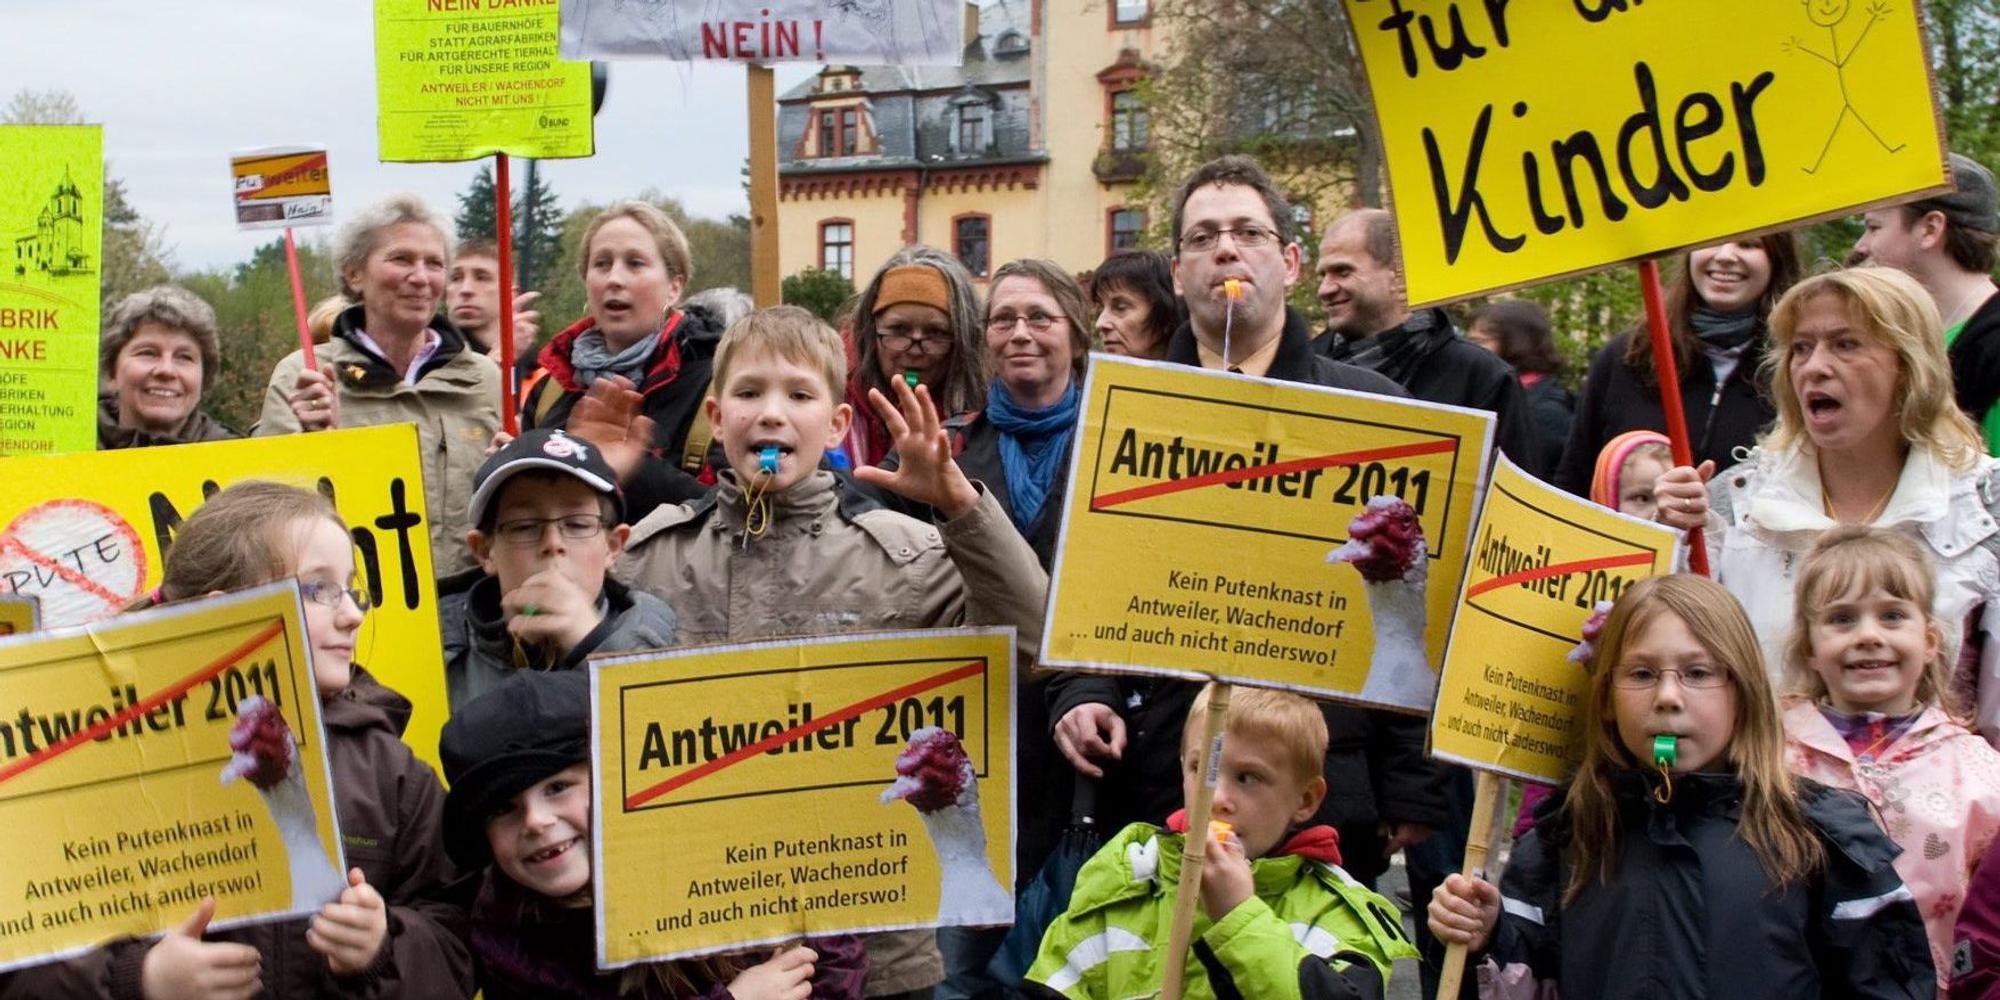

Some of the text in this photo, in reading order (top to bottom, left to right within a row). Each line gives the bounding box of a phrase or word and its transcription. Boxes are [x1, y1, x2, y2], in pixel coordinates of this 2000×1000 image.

[430, 32, 556, 48] STATT AGRARFABRIKEN
[446, 19, 544, 33] FÜR BAUERNHÖFE
[400, 50, 424, 62] FÜR
[427, 48, 510, 61] ARTGERECHTE
[440, 59, 551, 75] FÜR UNSERE REGION
[421, 82, 487, 94] ANTWEILER
[496, 78, 566, 91] WACHENDORF
[456, 96, 488, 107] NICHT
[492, 95, 510, 105] MIT
[513, 94, 534, 104] UNS
[1421, 61, 1775, 266] Kinder
[1109, 427, 1431, 516] Antweiler 2011
[1168, 570, 1347, 611] Kein Putenknast in
[1127, 596, 1345, 639] Antweiler, Wachendorf
[1094, 623, 1127, 641] und
[1132, 627, 1175, 647] auch
[1180, 630, 1228, 652] nicht
[1233, 638, 1336, 667] anderswo!
[202, 657, 282, 722] 2011
[1483, 664, 1504, 686] Kein
[1505, 671, 1563, 704] Putenknast
[1448, 714, 1463, 732] und
[1462, 718, 1482, 739] auch
[1483, 723, 1509, 744] nicht
[1463, 687, 1575, 732] Antweiler, Wachendorf
[638, 695, 965, 771] Antweiler 2011
[63, 810, 254, 862] Kein Putenknast in
[726, 829, 907, 864] Kein Putenknast in
[25, 839, 259, 900] Antweiler, Wachendorf
[687, 856, 908, 899] Antweiler, Wachendorf
[41, 902, 92, 930] auch
[100, 893, 152, 917] nicht
[158, 871, 262, 906] anderswo!
[656, 909, 692, 932] und
[698, 903, 743, 926] auch
[749, 896, 798, 918] nicht
[804, 885, 907, 911] anderswo!
